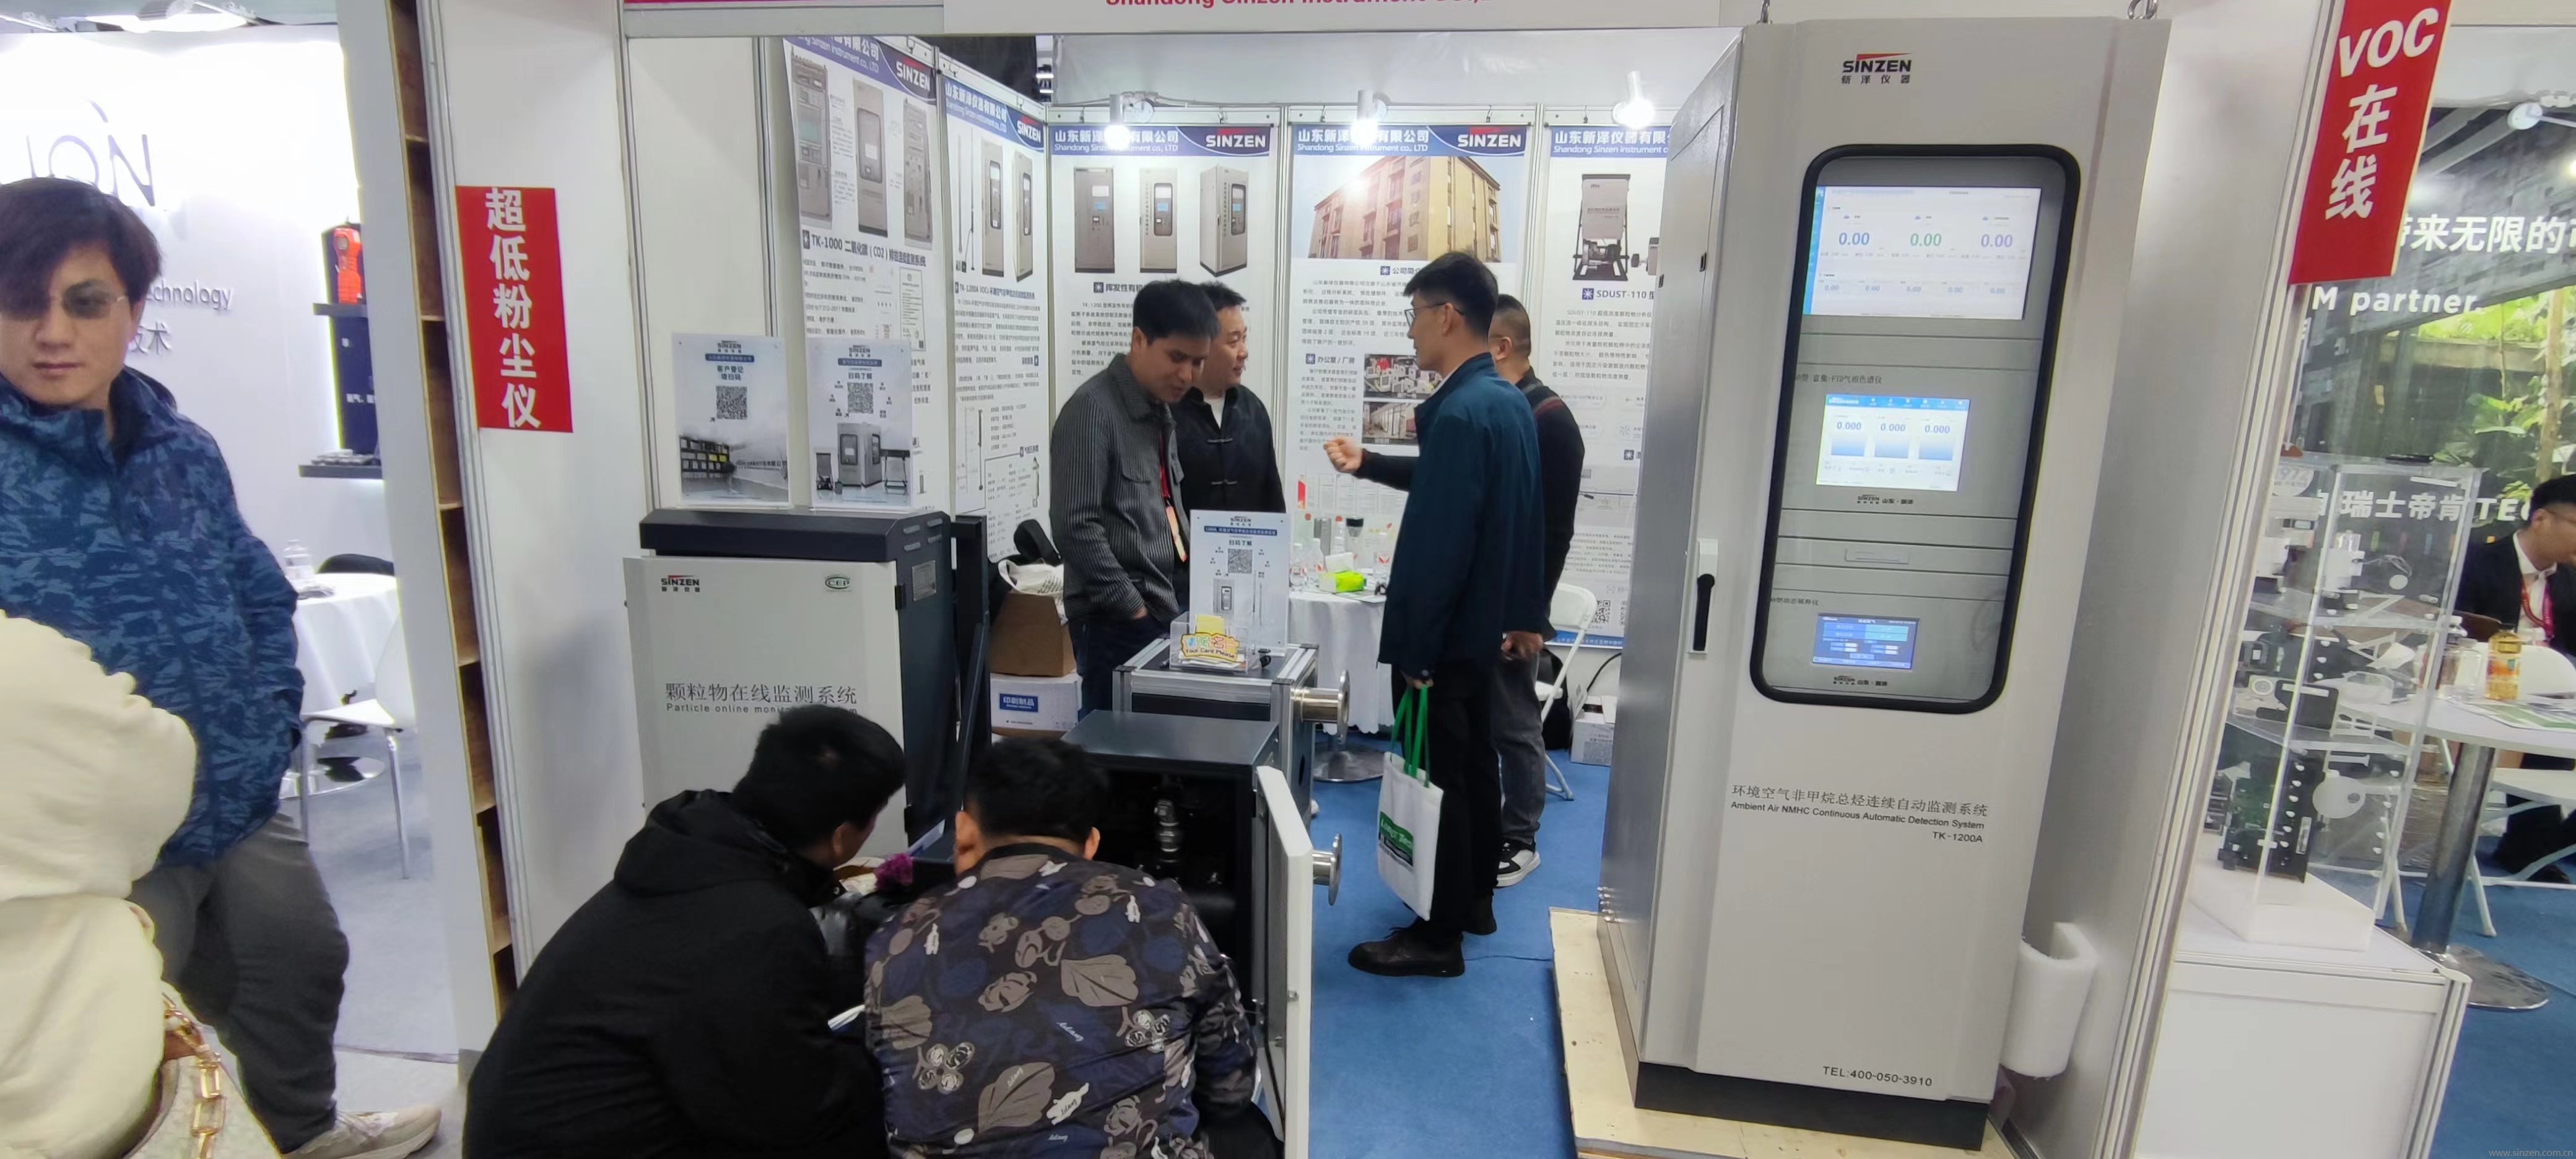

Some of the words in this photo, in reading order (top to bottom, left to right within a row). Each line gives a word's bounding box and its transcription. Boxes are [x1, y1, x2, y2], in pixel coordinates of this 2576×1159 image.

[2339, 7, 2440, 78] VOC
[1842, 59, 1912, 73] SINZEN
[895, 61, 931, 92] SINZEN
[1841, 74, 1911, 85] 新泽仪器
[1017, 119, 1041, 143] SINZEN
[1055, 129, 1178, 144] 山东新泽有限公司
[1298, 128, 1429, 144] 山东新泽有限公司
[1554, 130, 1670, 145] 山东新泽仪器有限
[1054, 144, 1090, 153] Shandong
[1205, 134, 1266, 149] SINZEN
[1297, 144, 1334, 153] Shandong
[1414, 144, 1429, 152] LTD
[1457, 134, 1521, 149] SINZEN
[1554, 145, 1593, 154] Shandong
[1593, 145, 1619, 154] Sinzen
[2324, 84, 2398, 221] 在线
[1838, 232, 1870, 246] 0.00
[1910, 233, 1942, 246] 0.00
[1981, 234, 2013, 248] 0.00
[2400, 213, 2576, 254] 来无限的
[811, 234, 843, 251] TK-1000
[1596, 290, 1647, 299] SDUST-110
[485, 188, 541, 429] 超低粉尘仪
[2350, 289, 2484, 317] partner.
[1836, 422, 1862, 431] 0.000
[1880, 423, 1906, 432] 0.000
[1925, 425, 1951, 434] 0.000
[661, 578, 700, 586] SINZEN
[666, 683, 858, 705] 颗粒物在线监测系统
[666, 703, 710, 713] Particle
[715, 703, 749, 713] online
[1731, 784, 1988, 817] 环境空气非甲烷总烃连续自动监测系统
[1731, 801, 1766, 812] Ambient
[1767, 804, 1780, 812] Air
[1782, 805, 1810, 815] NMHC
[1812, 807, 1861, 820] Continuous
[1862, 812, 1906, 824] Automatic
[1908, 815, 1949, 828] Detection
[1951, 819, 1985, 831] System
[1823, 1066, 1933, 1087] TEL:400-050-3910
